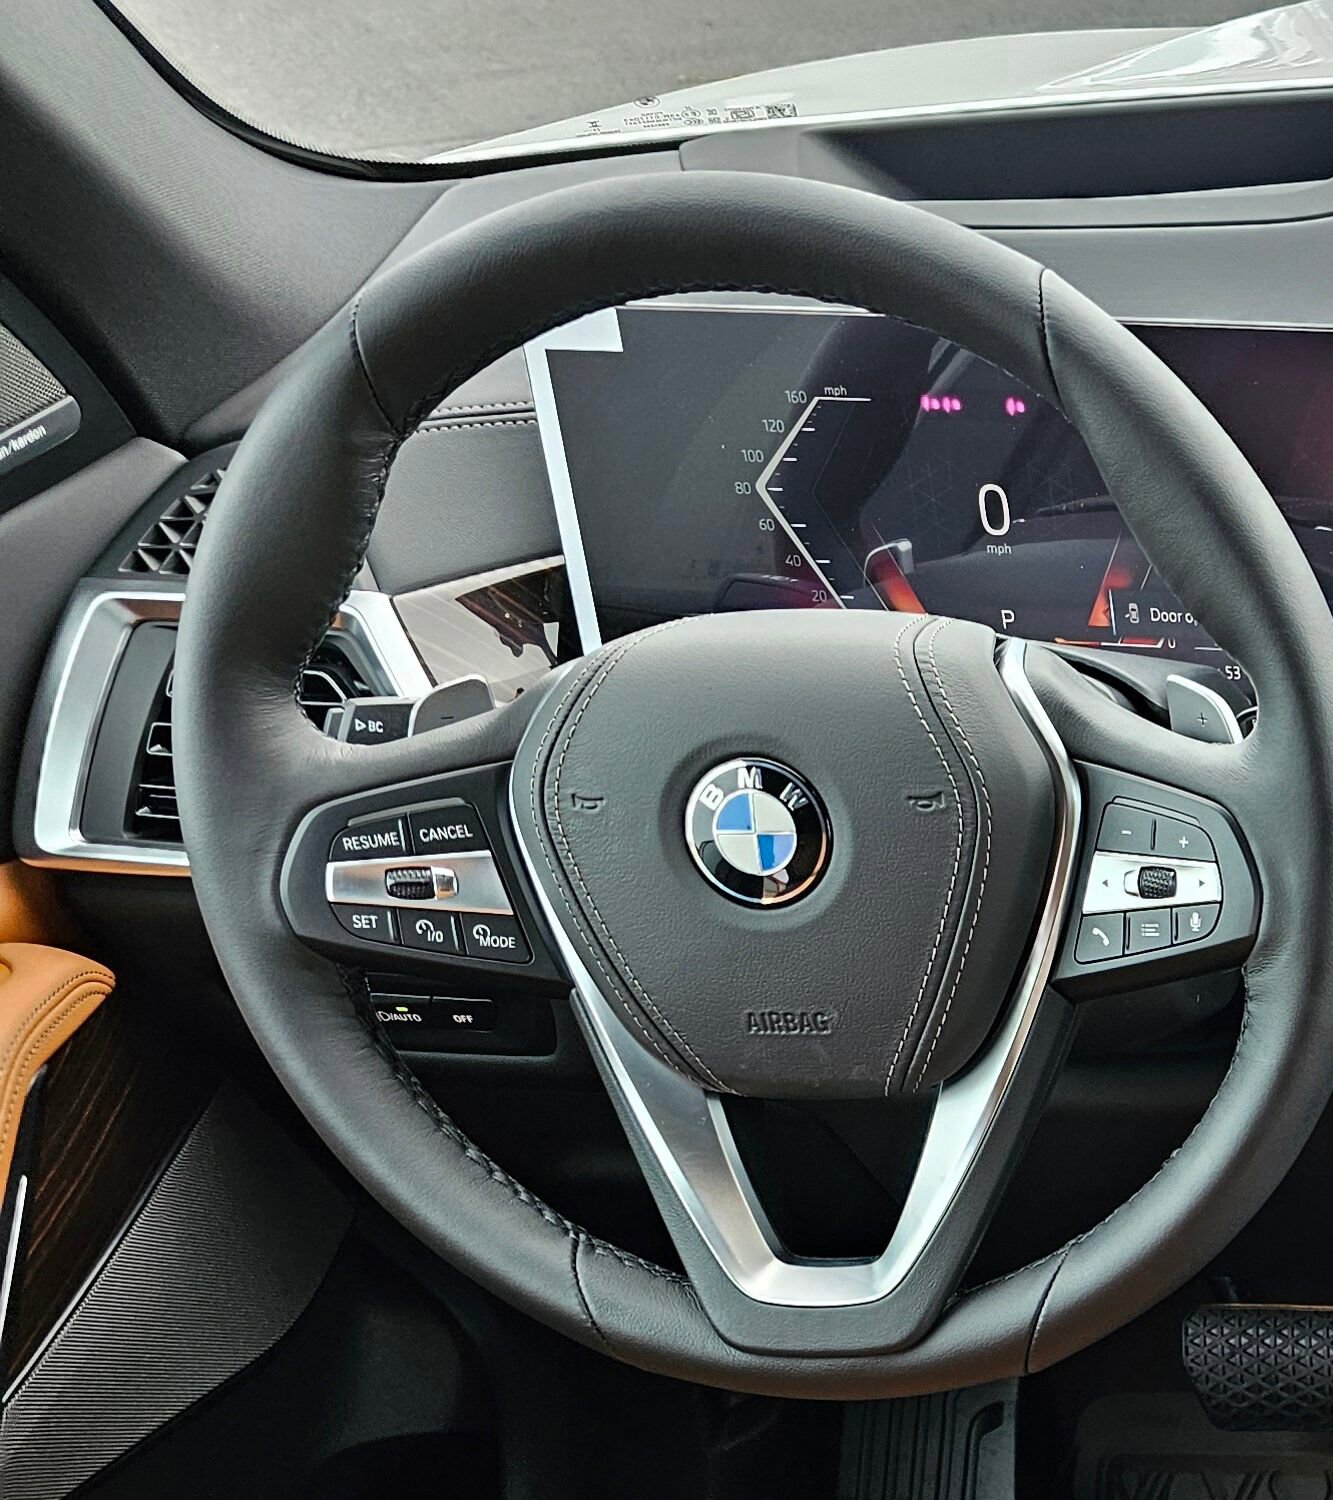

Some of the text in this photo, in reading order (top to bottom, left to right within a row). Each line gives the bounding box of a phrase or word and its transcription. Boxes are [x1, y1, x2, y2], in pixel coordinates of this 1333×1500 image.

[784, 390, 807, 404] 160
[824, 385, 847, 396] mph
[762, 419, 785, 433] 120
[742, 449, 764, 463] 100
[734, 481, 751, 495] 80
[978, 483, 1011, 536] 0
[759, 518, 775, 532] 60
[986, 543, 1012, 556] mph
[785, 554, 802, 567] 40
[811, 590, 828, 602] 20
[1001, 609, 1015, 630] P
[1149, 607, 1182, 623] Door
[368, 720, 384, 733] BC
[700, 766, 809, 812] BMW
[419, 824, 474, 843] CANCEL
[342, 831, 400, 851] RESUME
[352, 915, 378, 929] SET
[479, 935, 516, 949] MODE
[452, 1014, 473, 1024] OFF
[746, 1010, 832, 1035] AIRBAG
